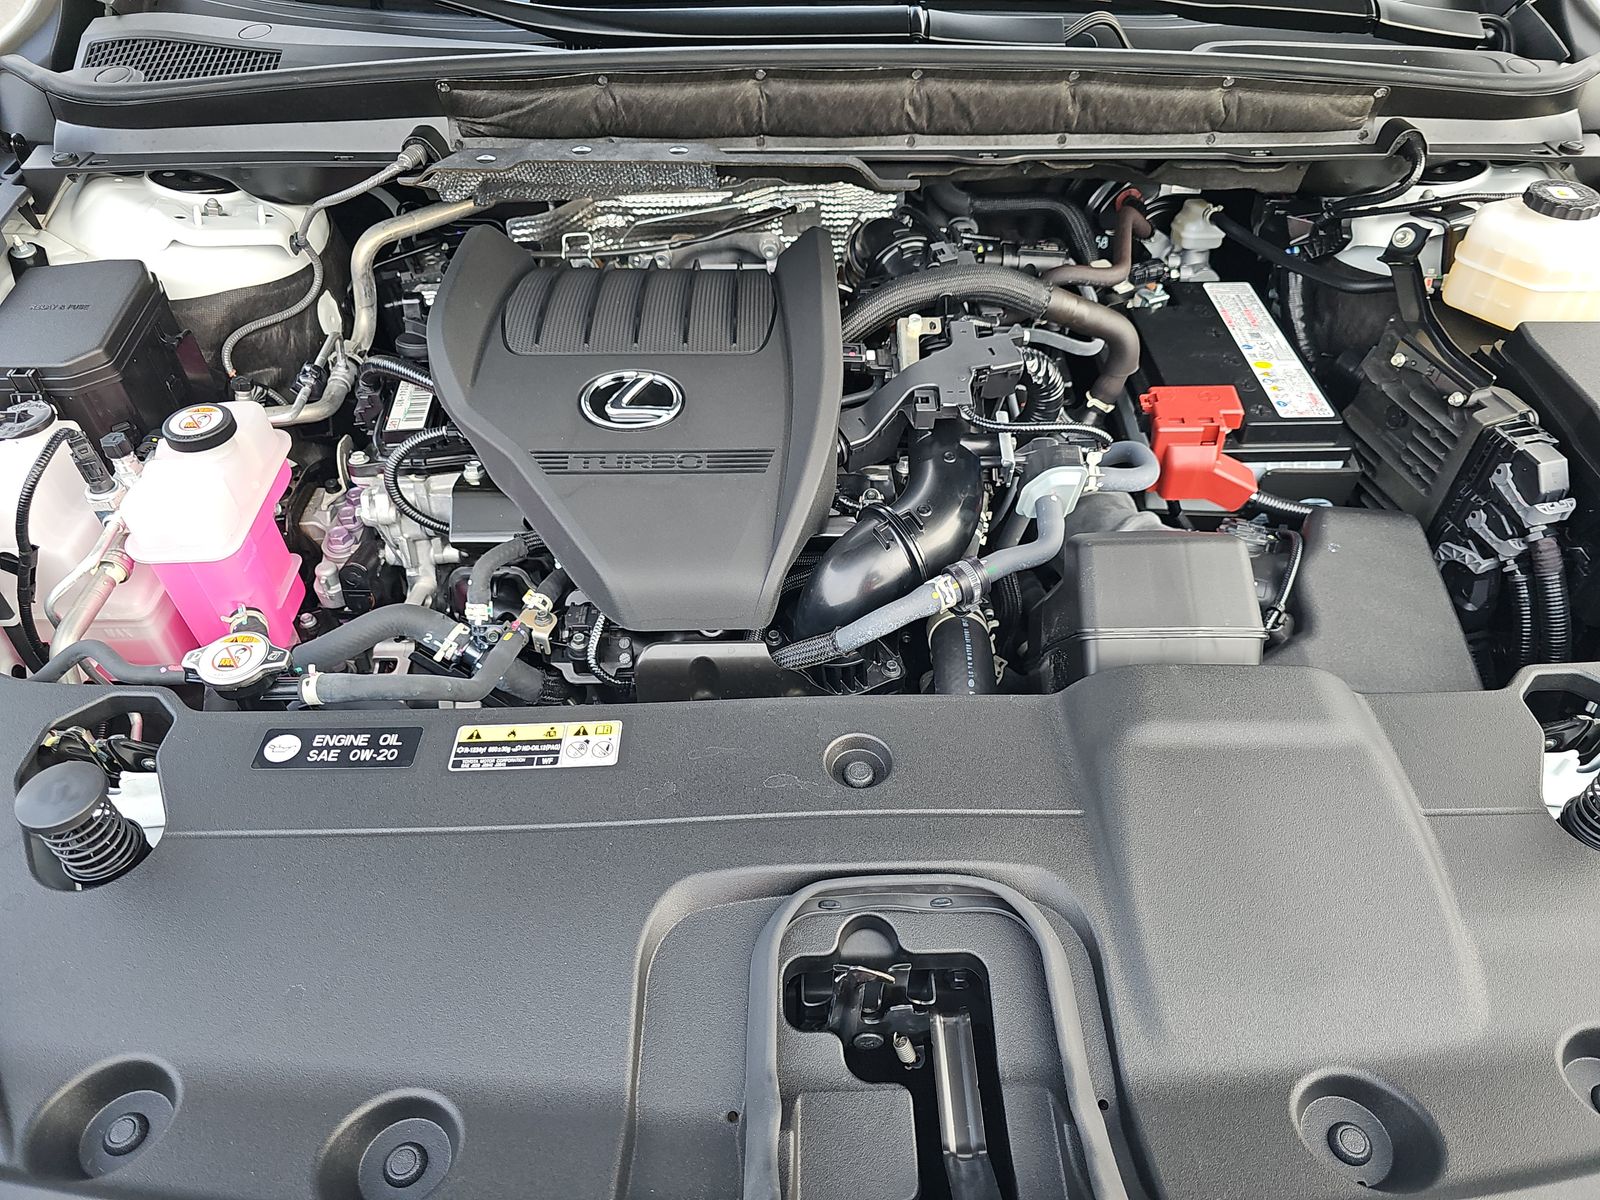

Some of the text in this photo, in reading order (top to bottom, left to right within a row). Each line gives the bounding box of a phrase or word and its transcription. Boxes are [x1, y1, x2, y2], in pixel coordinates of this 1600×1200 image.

[572, 452, 704, 470] TURBO
[312, 734, 403, 747] ENGINE OIL
[307, 748, 399, 762] SAE 0W-20
